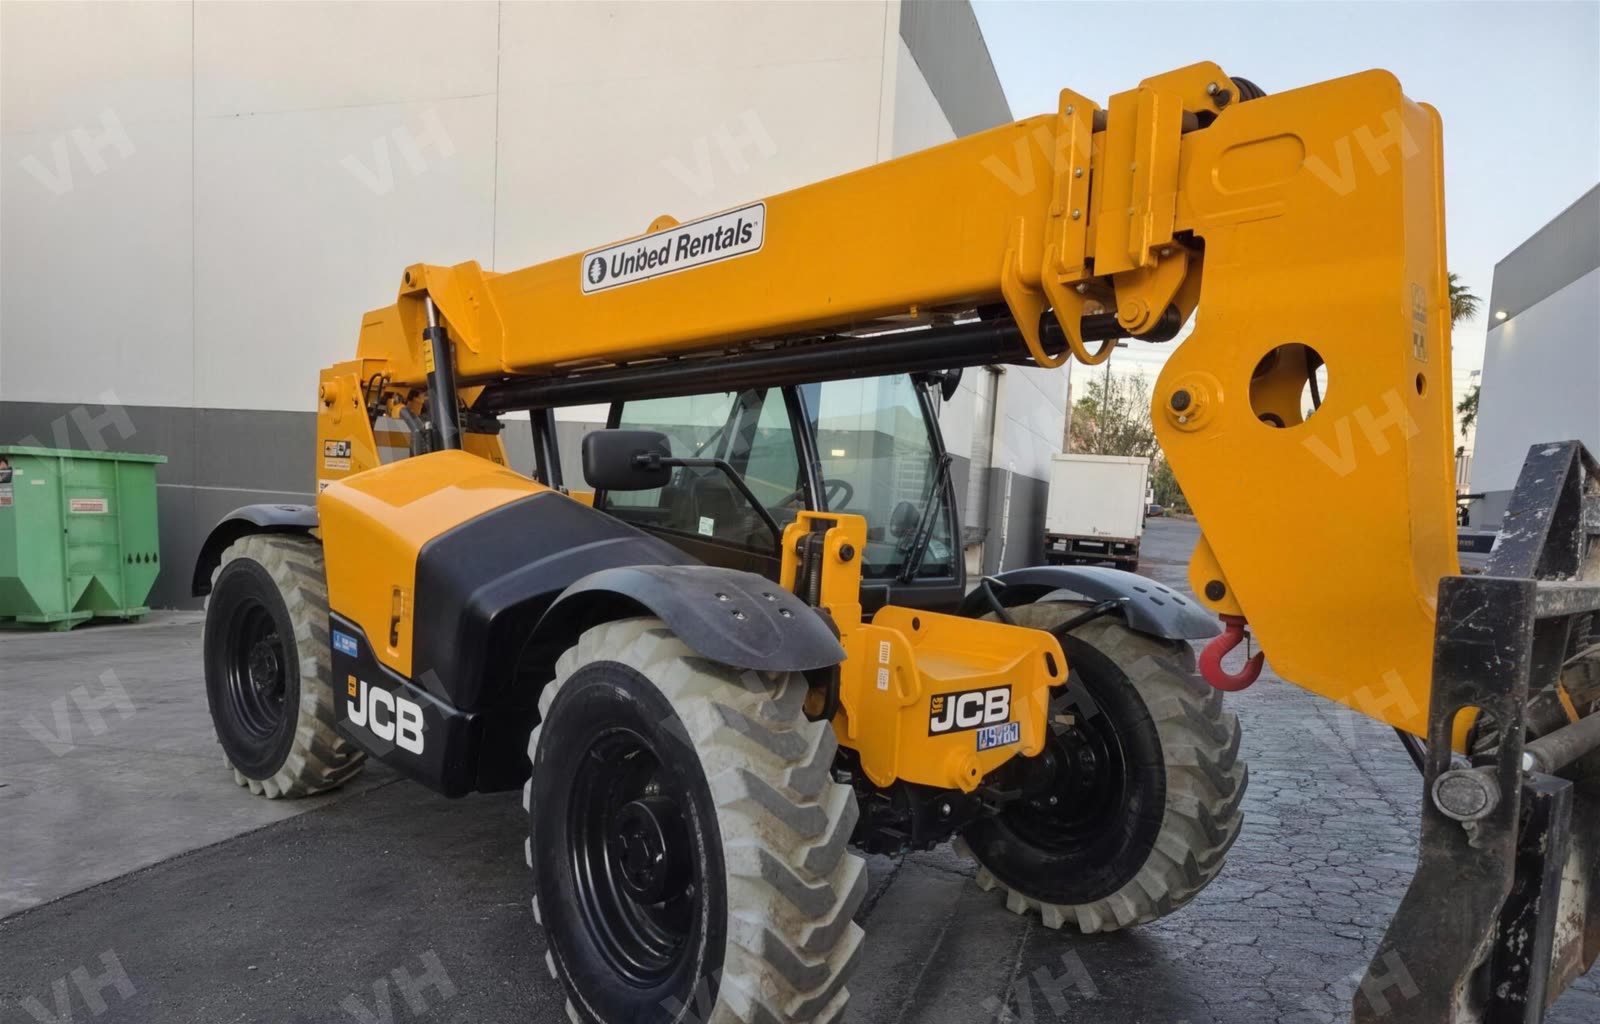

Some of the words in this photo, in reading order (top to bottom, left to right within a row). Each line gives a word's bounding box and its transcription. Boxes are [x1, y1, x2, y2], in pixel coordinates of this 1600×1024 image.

[675, 218, 752, 261] Rentals
[347, 680, 424, 755] JCB
[930, 688, 1010, 732] JCB
